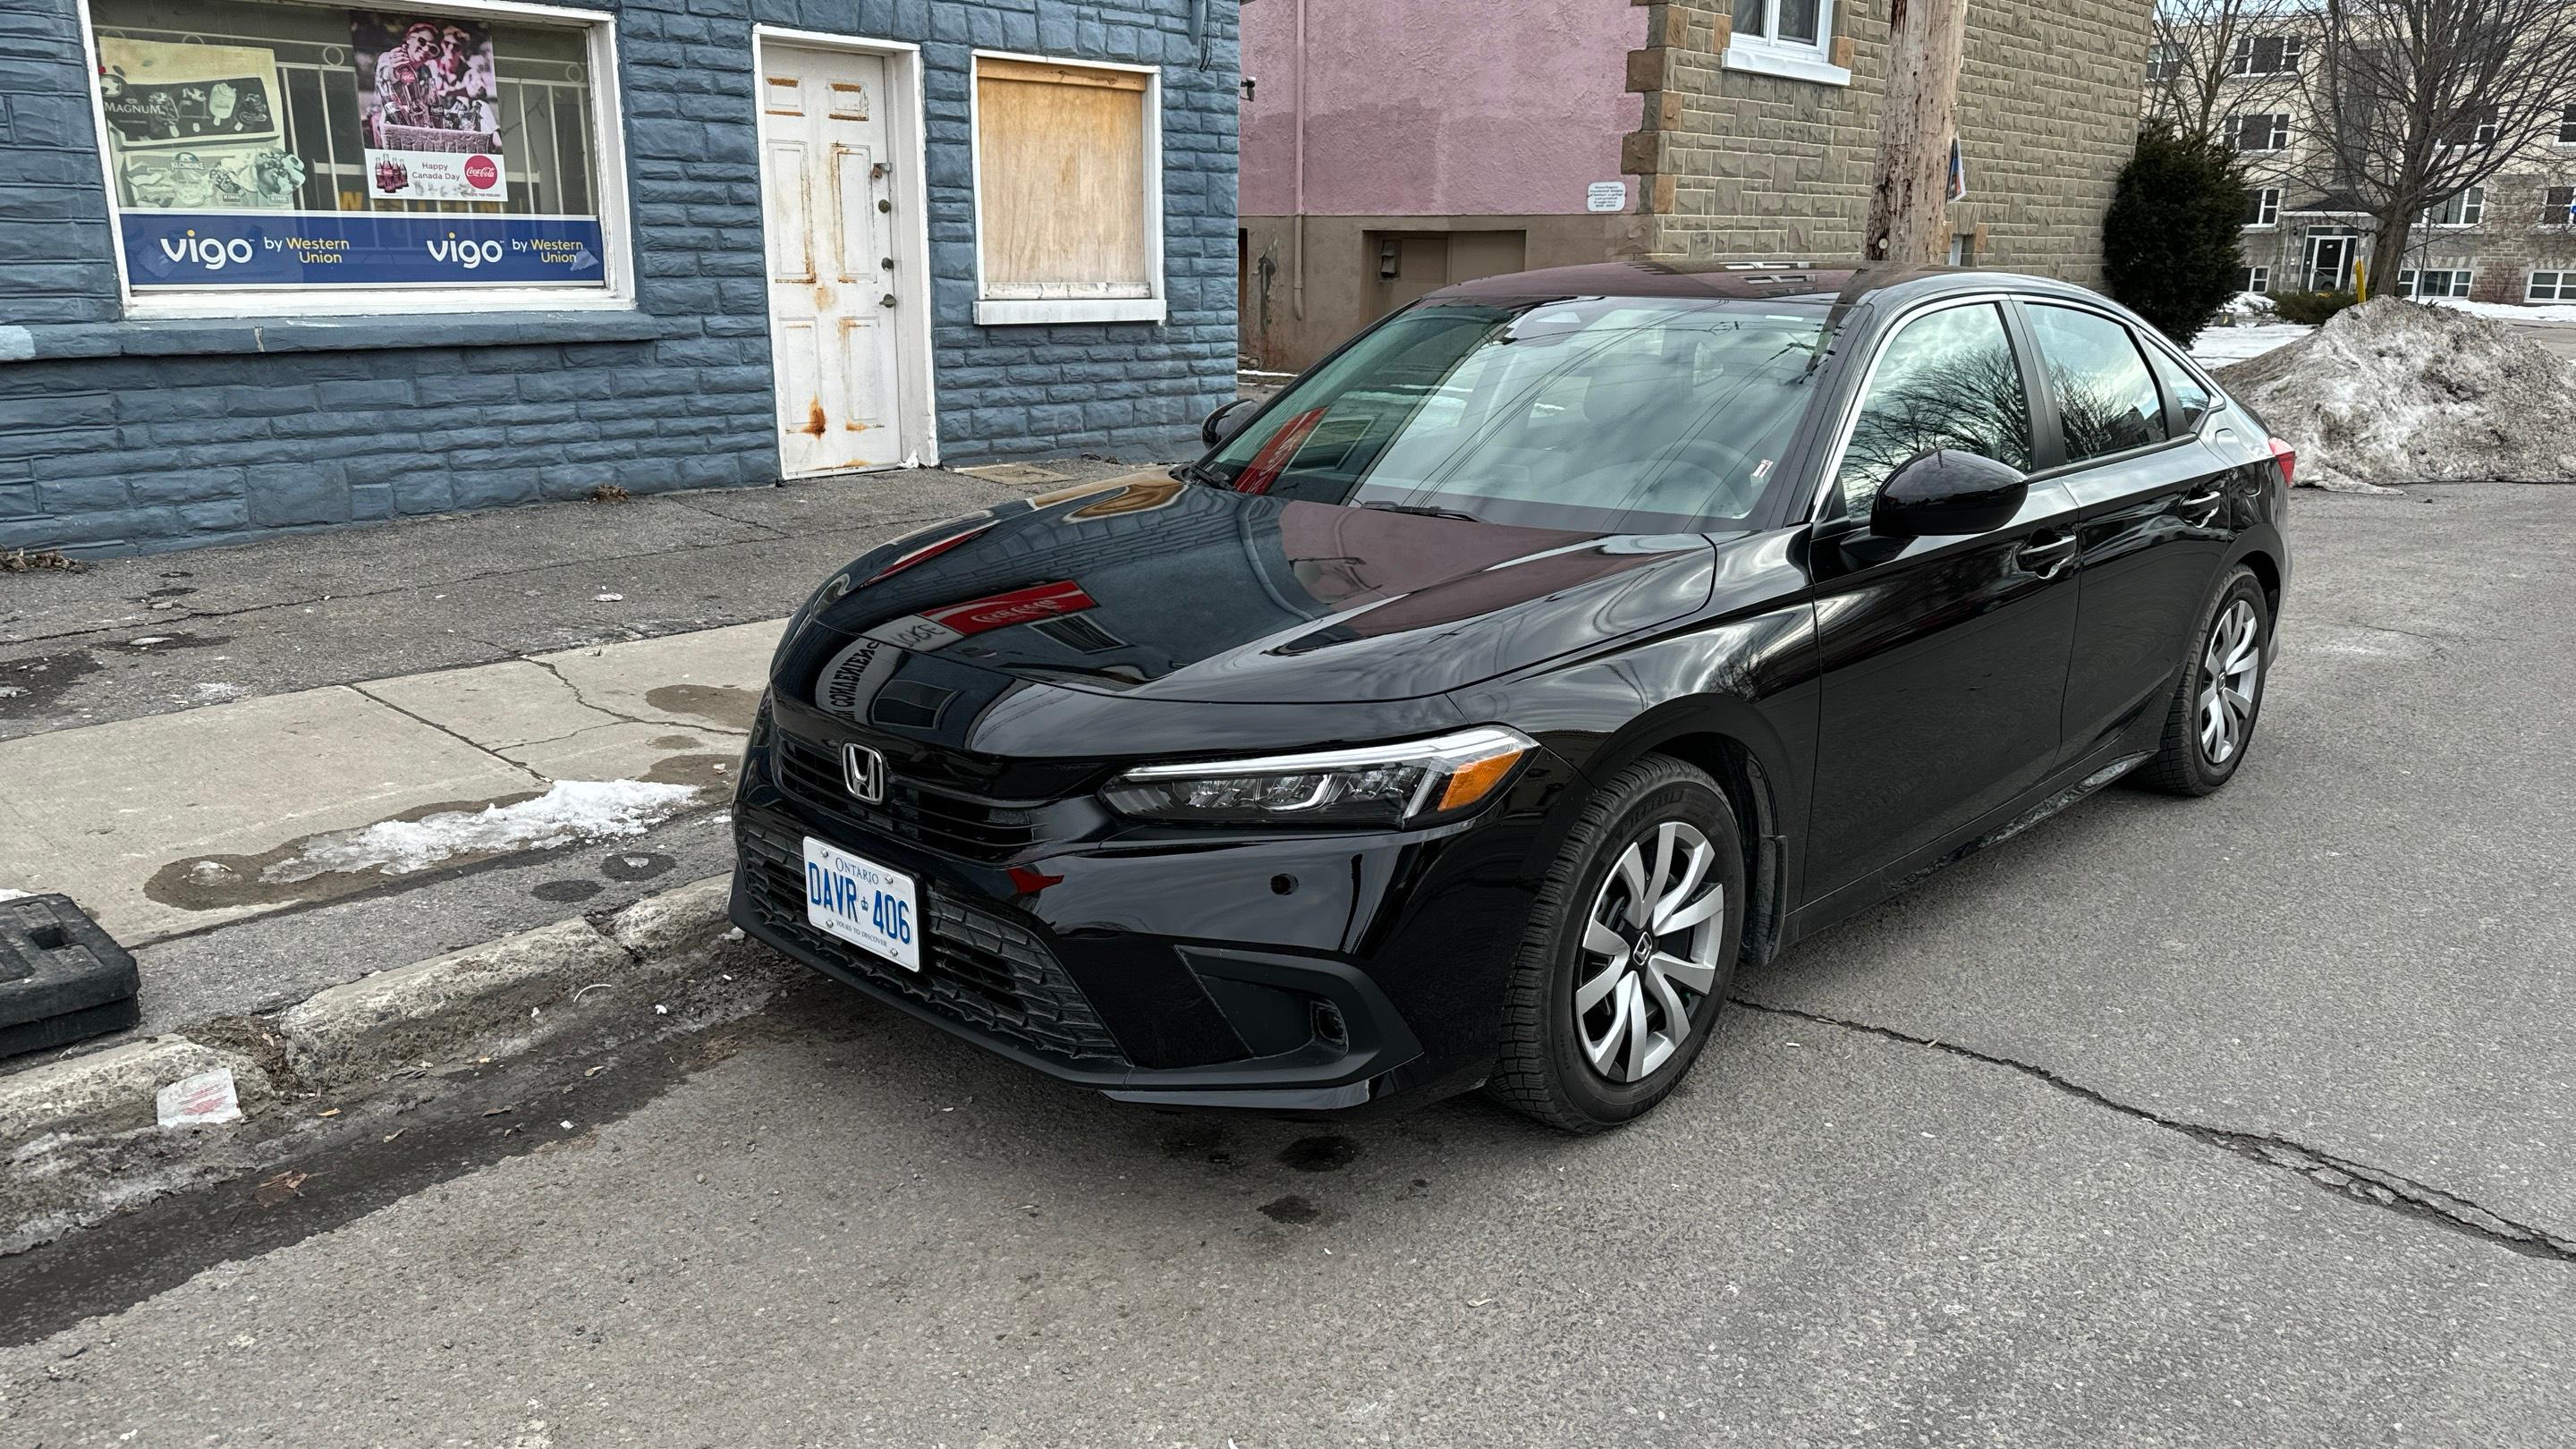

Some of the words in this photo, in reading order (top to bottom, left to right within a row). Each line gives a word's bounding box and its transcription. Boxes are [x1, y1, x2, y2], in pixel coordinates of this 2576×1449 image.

[103, 101, 163, 114] MAGNUM
[411, 172, 443, 180] Canada
[445, 173, 461, 182] Day
[422, 162, 448, 171] Happy
[160, 229, 253, 270] vigo
[264, 236, 284, 252] by
[286, 237, 350, 250] Western
[299, 250, 343, 264] Union
[427, 232, 503, 269] vigo
[512, 238, 528, 252] by
[530, 239, 583, 250] Western
[540, 250, 578, 263] Union
[835, 857, 879, 885] ONTARIO
[808, 860, 859, 923] DAVR
[872, 889, 911, 945] 406
[835, 919, 852, 932] YOURS
[853, 927, 861, 936] TO
[861, 931, 888, 948] DISCOVER
